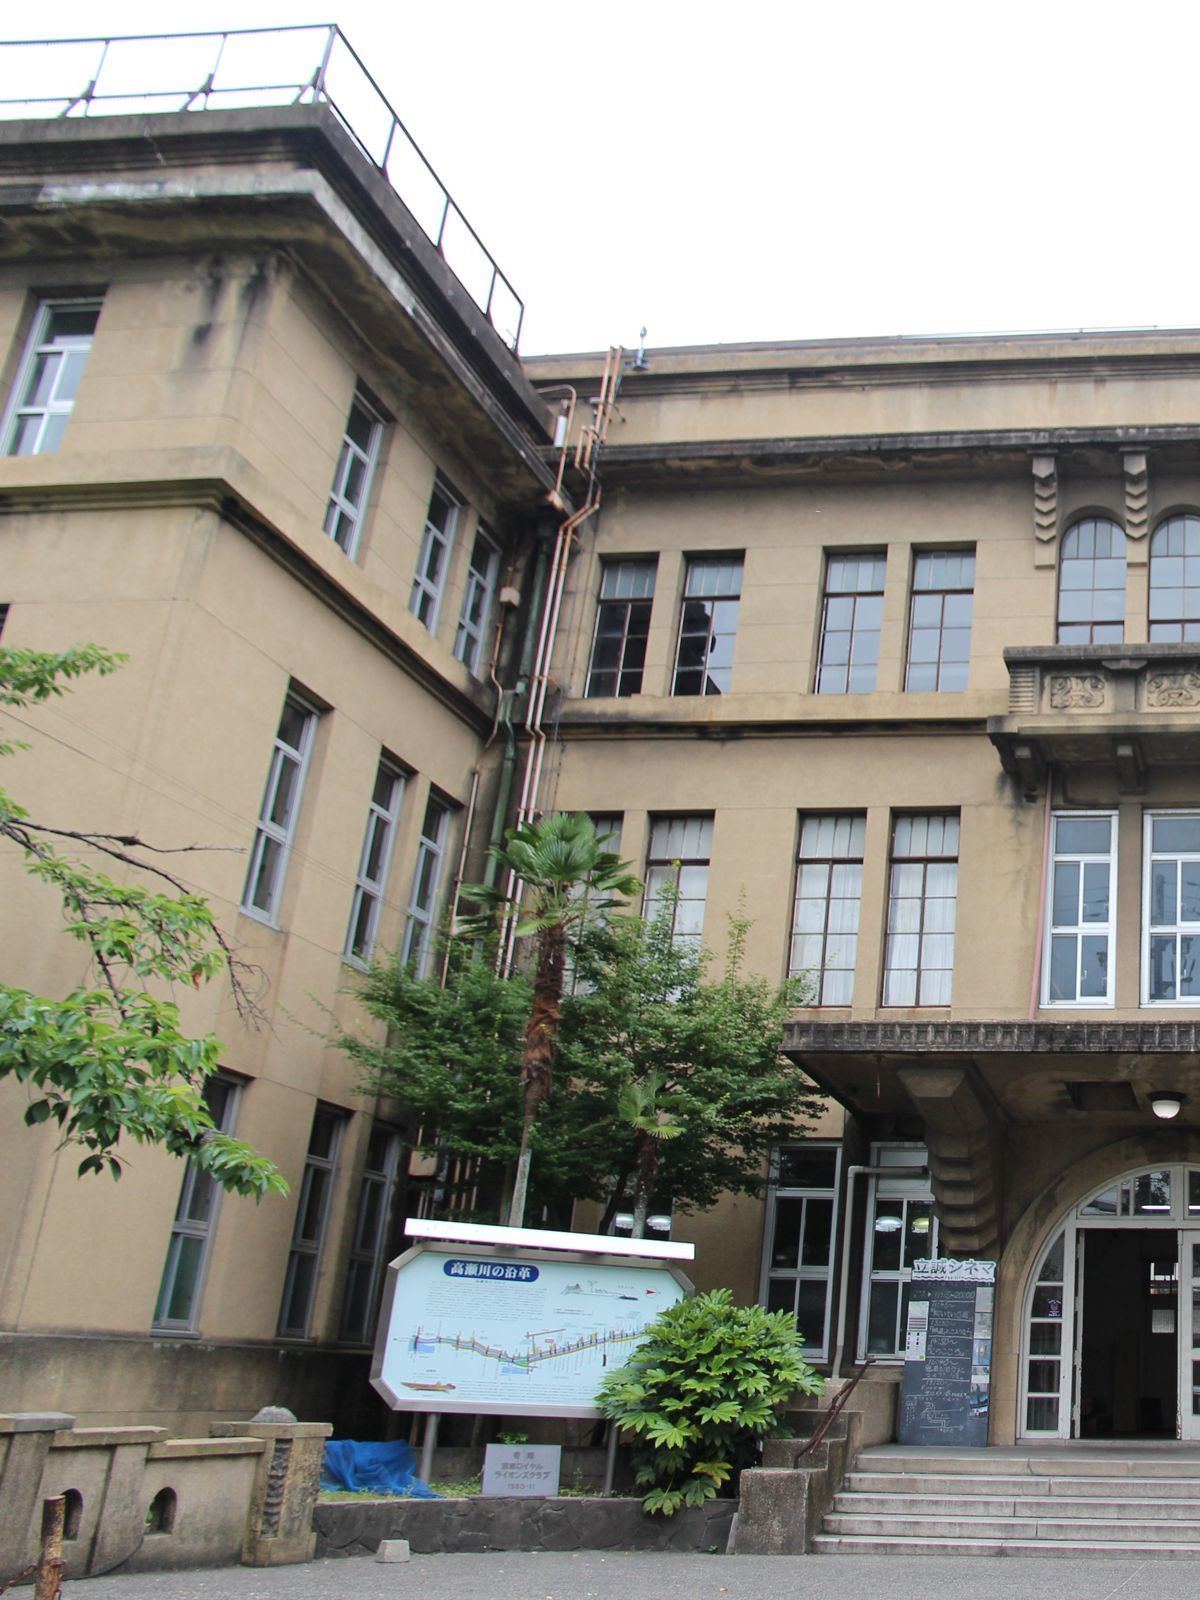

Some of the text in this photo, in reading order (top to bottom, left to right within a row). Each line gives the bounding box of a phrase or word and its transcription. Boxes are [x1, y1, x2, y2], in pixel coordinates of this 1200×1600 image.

[450, 1262, 532, 1280] 高瀬川の沿革
[913, 1260, 995, 1276] 立誠シネマ
